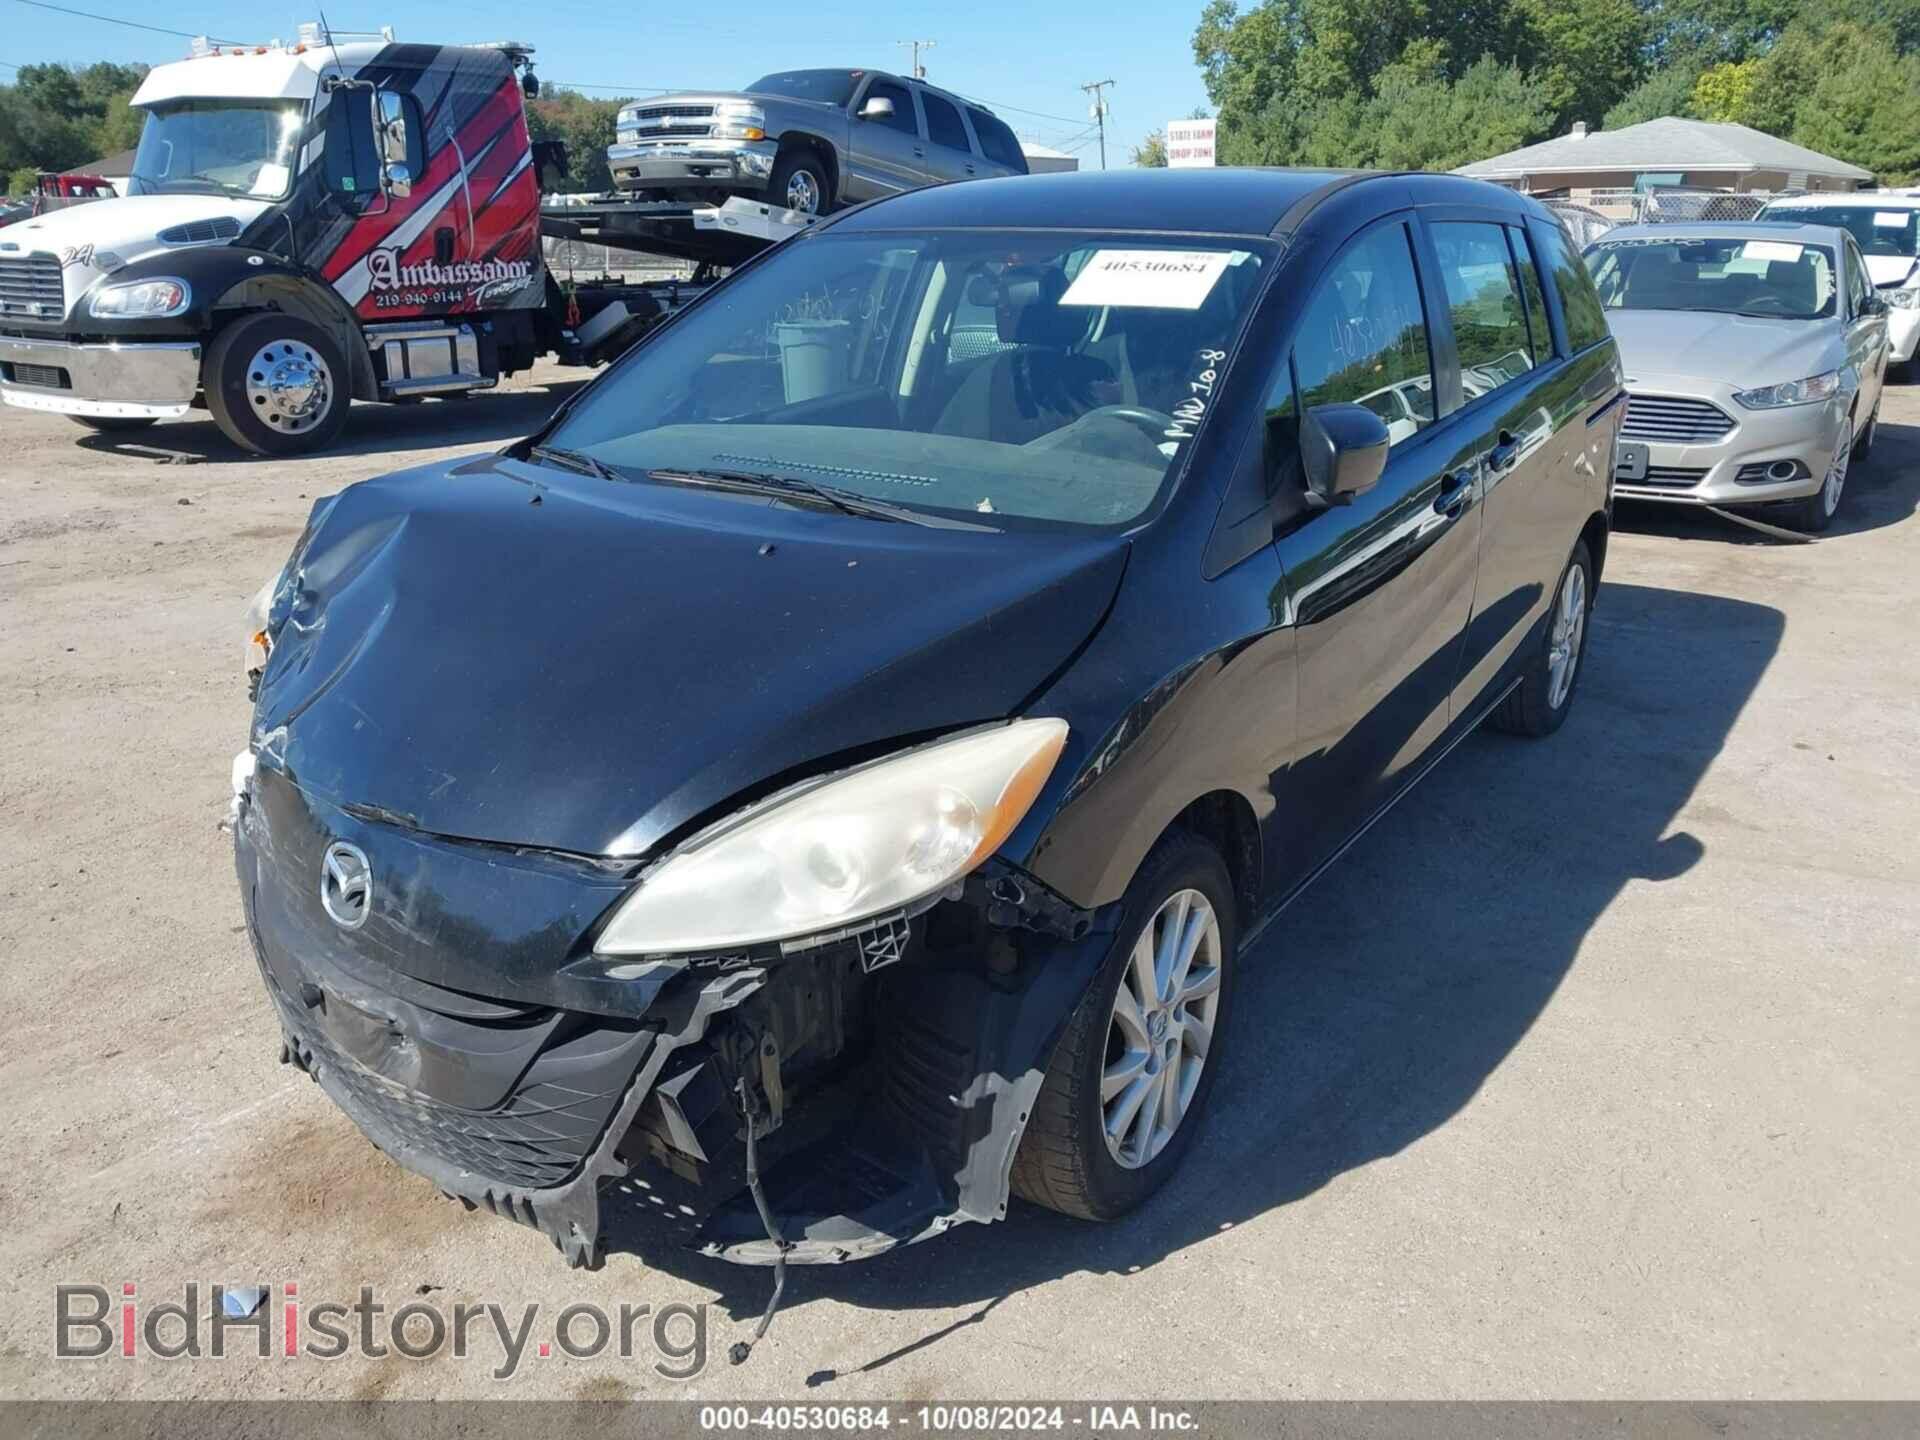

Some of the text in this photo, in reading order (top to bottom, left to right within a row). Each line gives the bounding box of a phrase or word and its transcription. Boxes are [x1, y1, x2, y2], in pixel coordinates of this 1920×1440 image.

[62, 242, 95, 270] 24
[1101, 261, 1207, 274] 40530684
[369, 248, 531, 291] Ambassador
[376, 289, 463, 307] 219-940-9144
